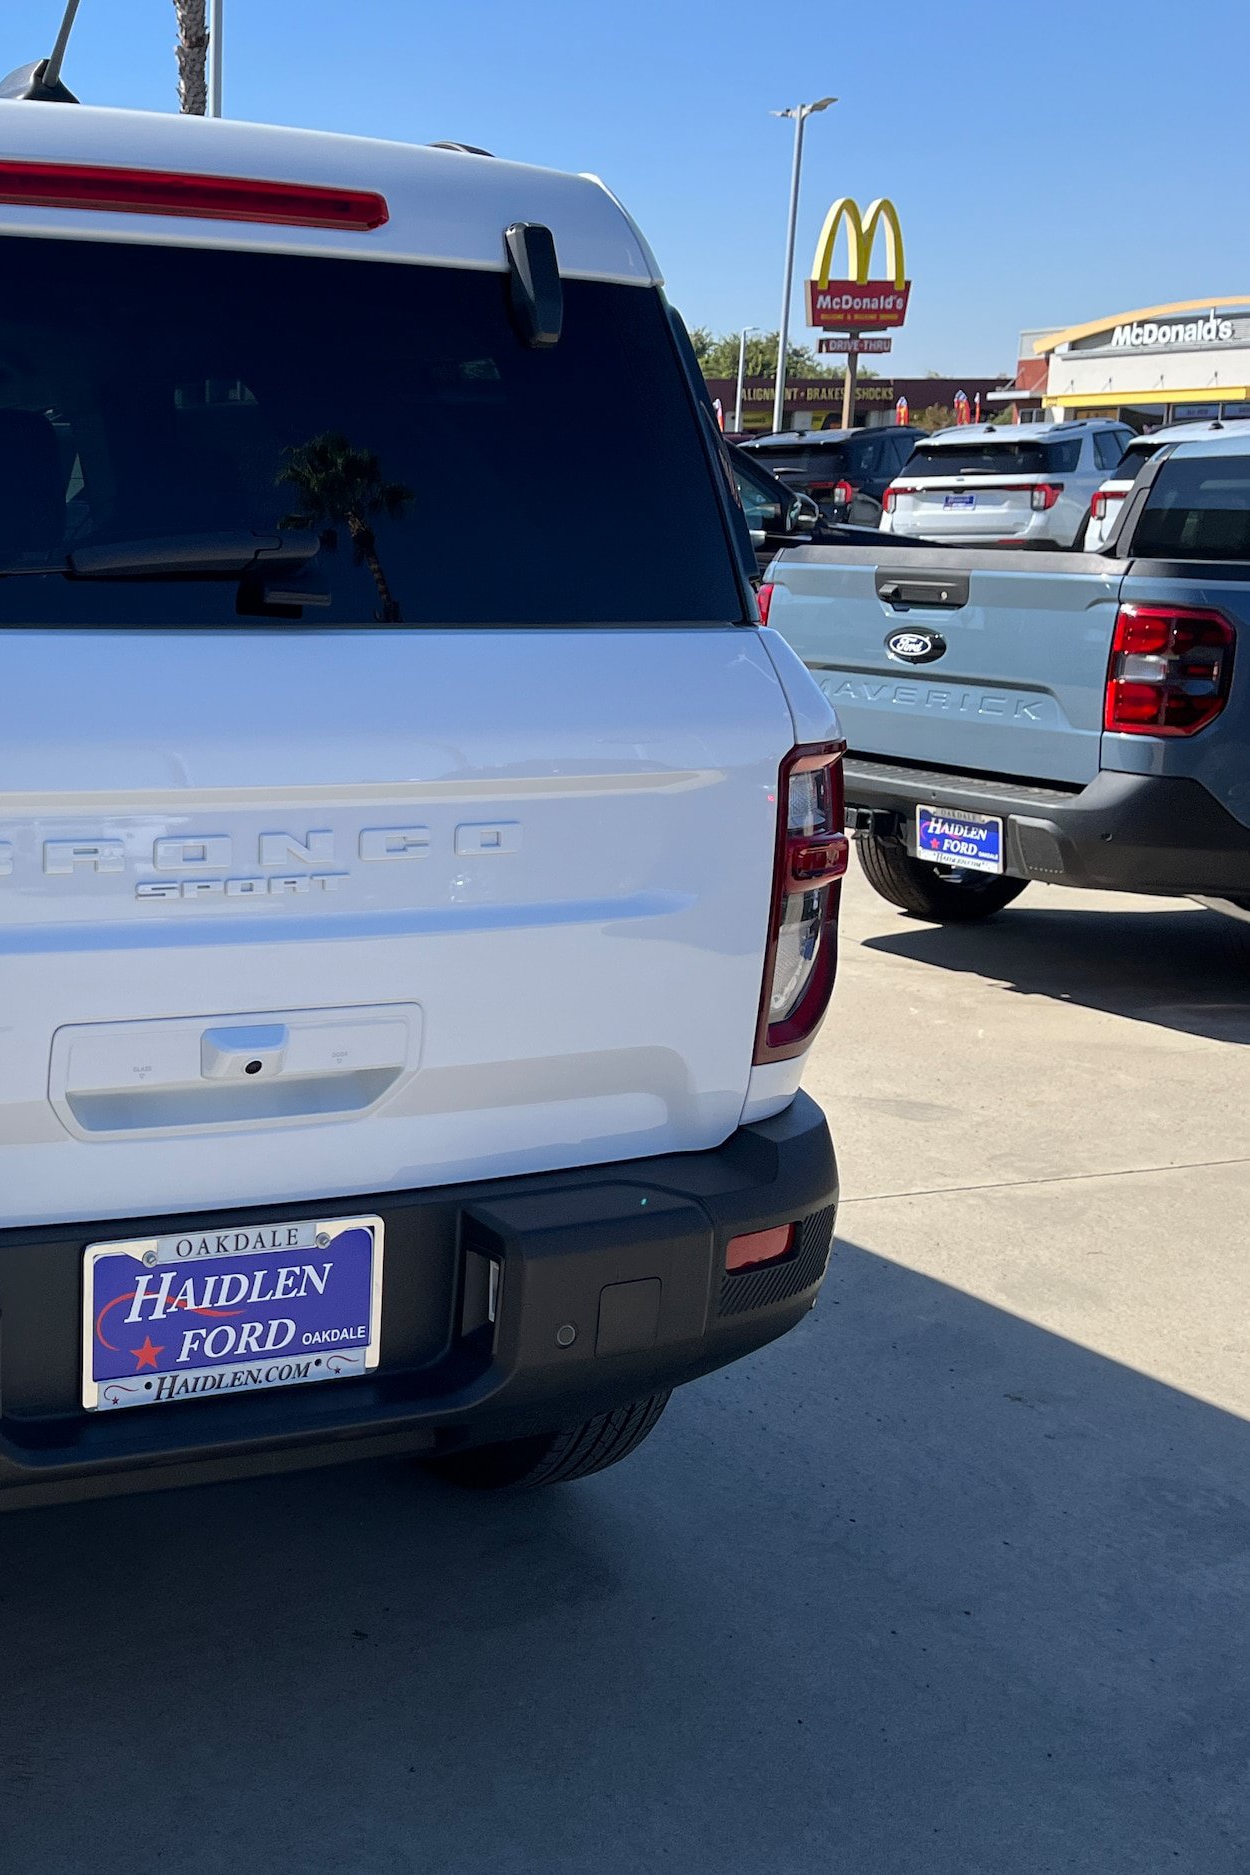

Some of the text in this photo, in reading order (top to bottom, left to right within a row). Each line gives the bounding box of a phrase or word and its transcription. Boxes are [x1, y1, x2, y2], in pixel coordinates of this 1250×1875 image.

[816, 295, 904, 310] McDonald's
[1111, 318, 1233, 347] McDonald's
[741, 387, 799, 401] ALIGNMNT
[855, 387, 894, 401] SHOCKS
[896, 637, 924, 653] Ford
[928, 817, 988, 841] HAIDLEN
[942, 838, 979, 856] FORD
[135, 872, 350, 900] SPORT
[176, 1228, 299, 1257] OAKDALE
[124, 1263, 333, 1323] HAIDLEN
[176, 1318, 366, 1363] FORD OAKDALE
[153, 1361, 313, 1402] HAIDLEN.COM
